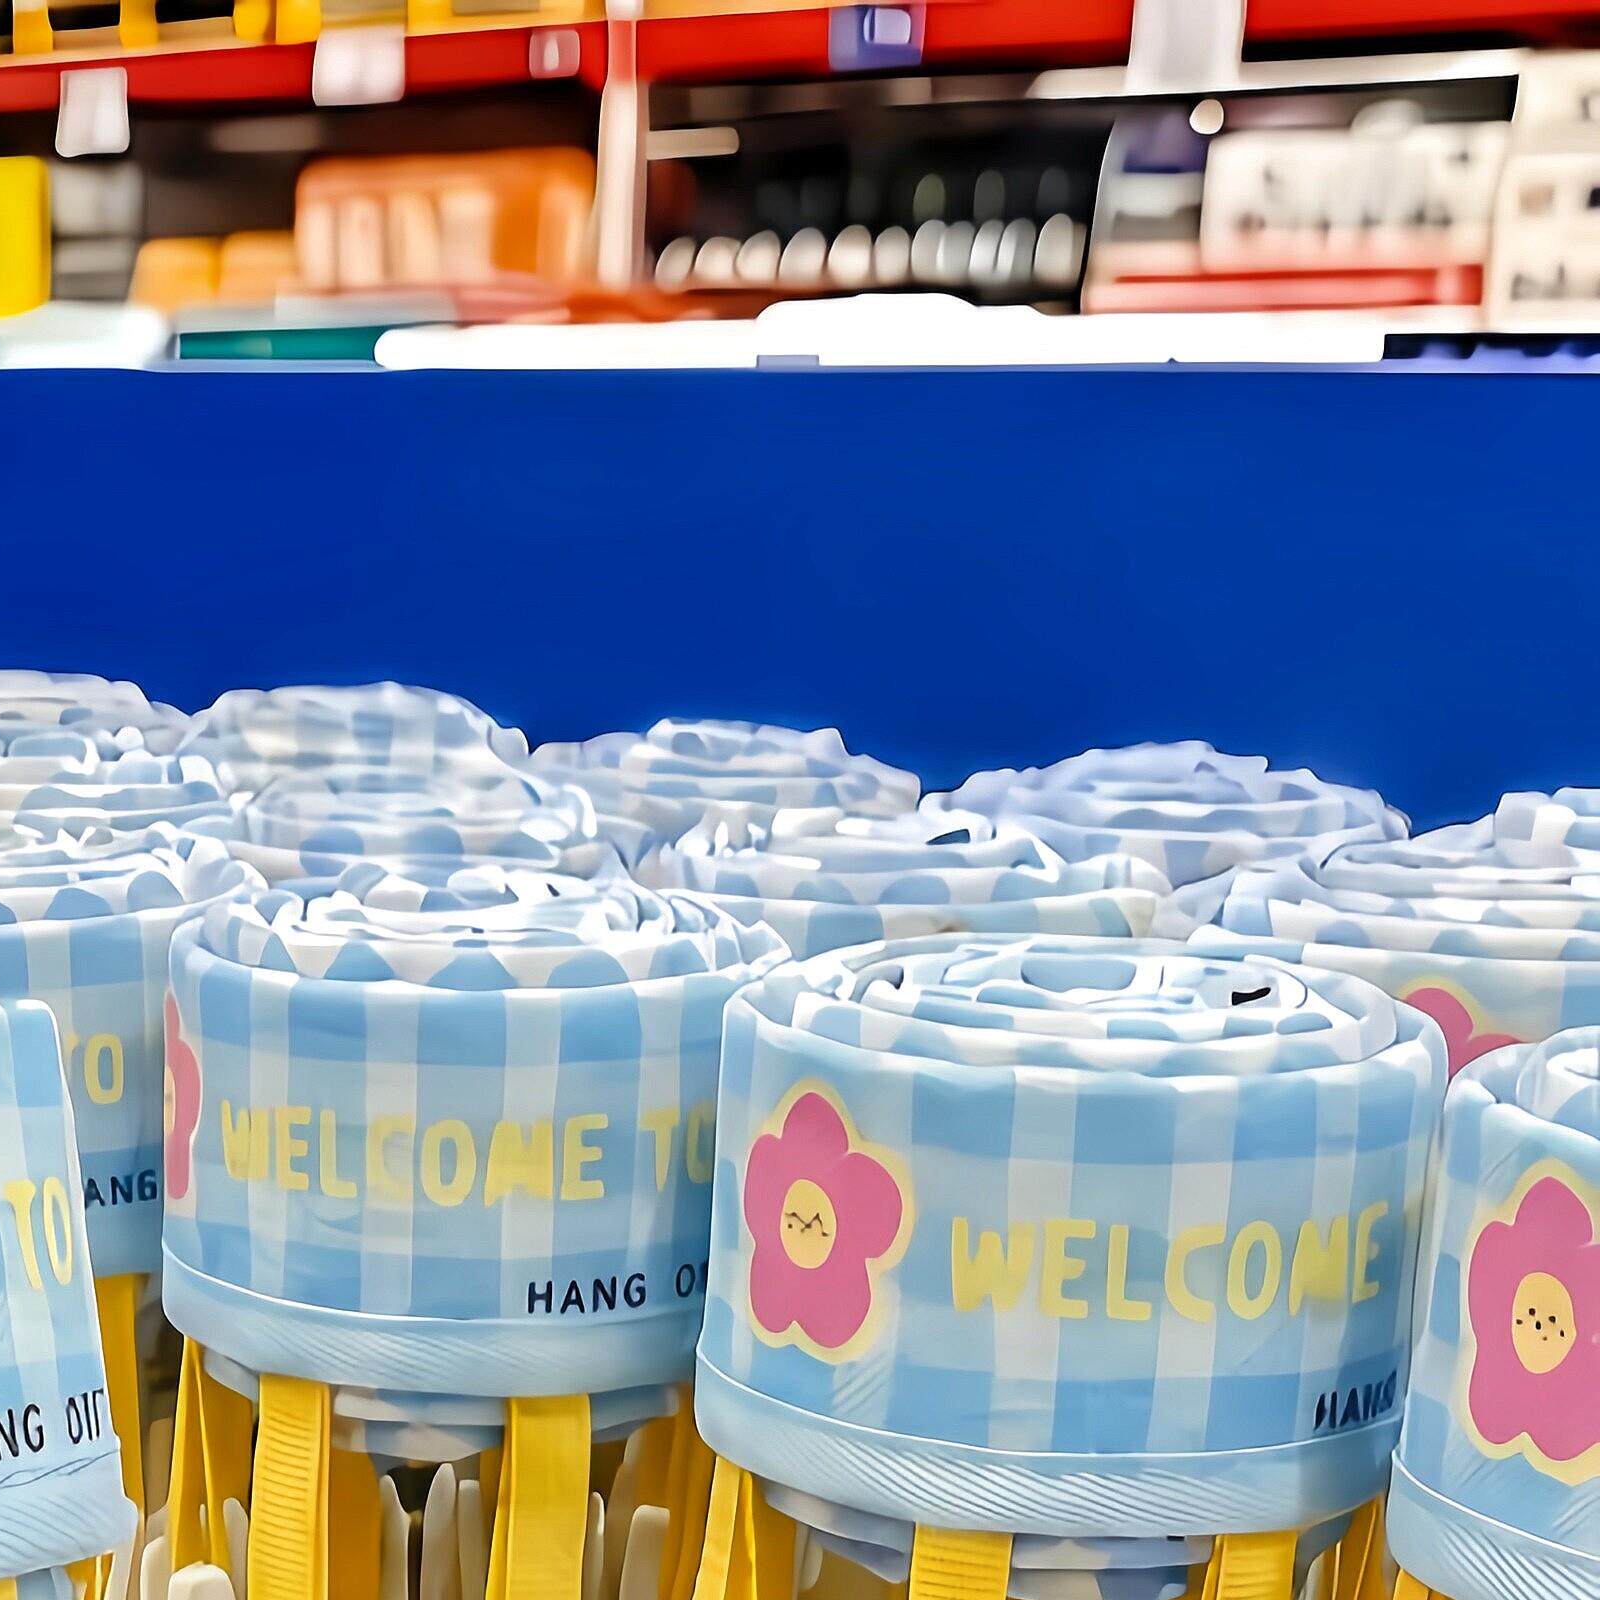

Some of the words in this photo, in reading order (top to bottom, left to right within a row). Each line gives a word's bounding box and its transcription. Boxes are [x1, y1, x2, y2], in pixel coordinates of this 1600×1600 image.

[221, 1099, 608, 1207] WELCOME
[5, 1176, 74, 1290] TO
[952, 1201, 1389, 1322] WELCOME
[527, 1272, 647, 1314] HANG
